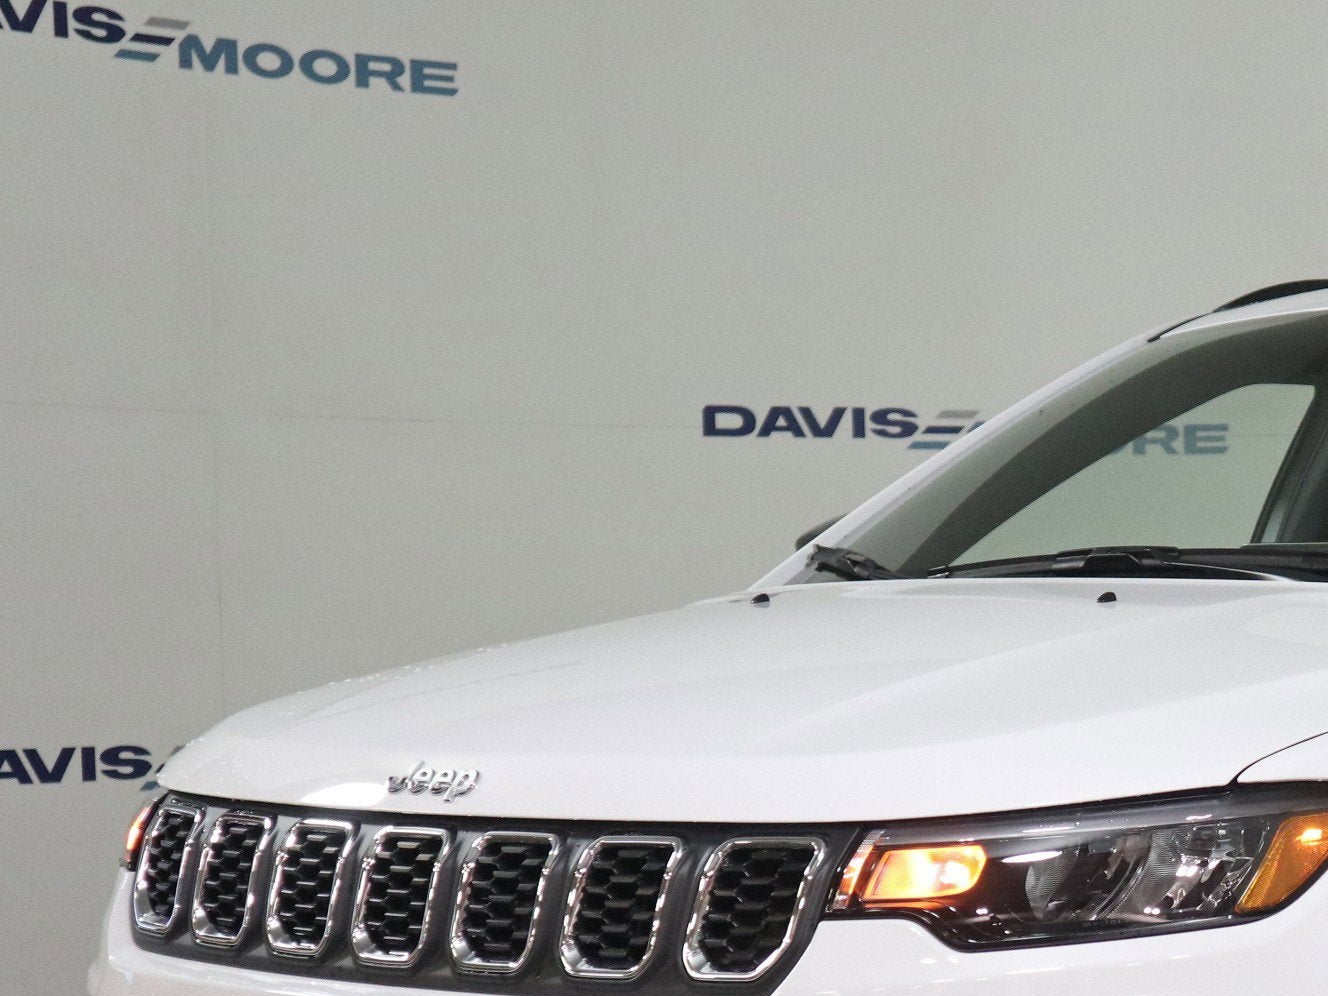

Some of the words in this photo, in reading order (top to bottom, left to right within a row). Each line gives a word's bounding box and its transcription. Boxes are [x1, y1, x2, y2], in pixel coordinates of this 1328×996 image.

[0, 0, 126, 43] VIS
[178, 34, 458, 97] MOORE
[702, 405, 918, 439] DAVIS
[387, 760, 480, 802] Jeep
